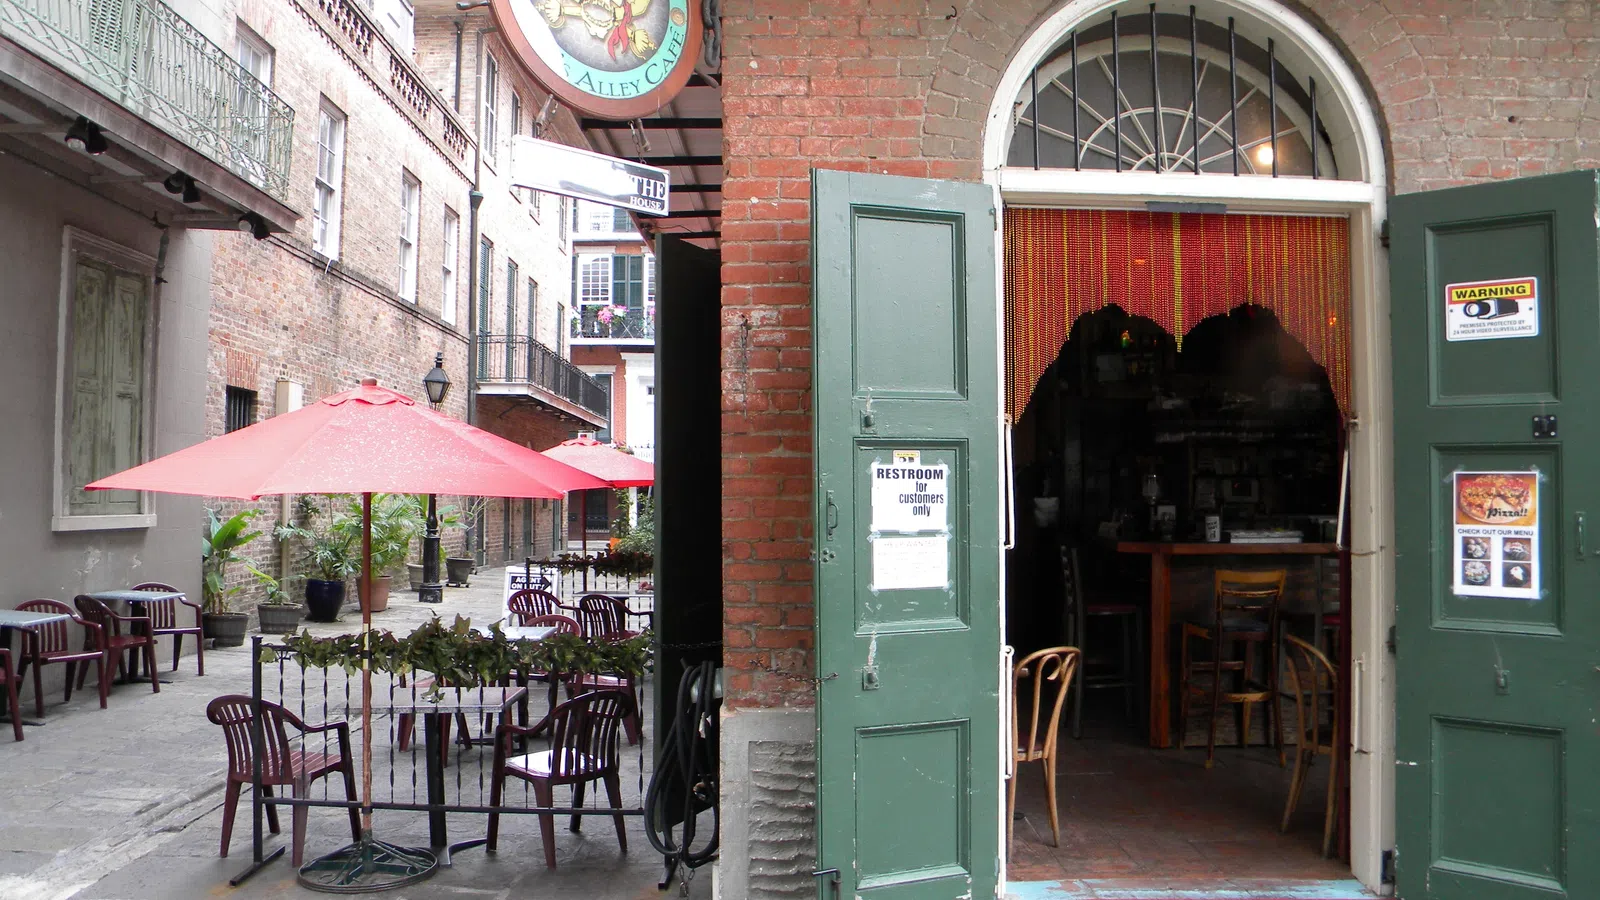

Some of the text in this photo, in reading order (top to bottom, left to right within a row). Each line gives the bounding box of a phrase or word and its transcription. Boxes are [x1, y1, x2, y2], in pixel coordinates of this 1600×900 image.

[575, 71, 641, 98] ALLEY
[630, 195, 662, 211] HOUSE
[1455, 285, 1526, 299] WARNING
[1493, 325, 1532, 333] SURVEILLANCE
[877, 468, 943, 480] RESTROOM
[915, 481, 928, 492] for
[899, 493, 944, 504] customers
[912, 504, 931, 517] only
